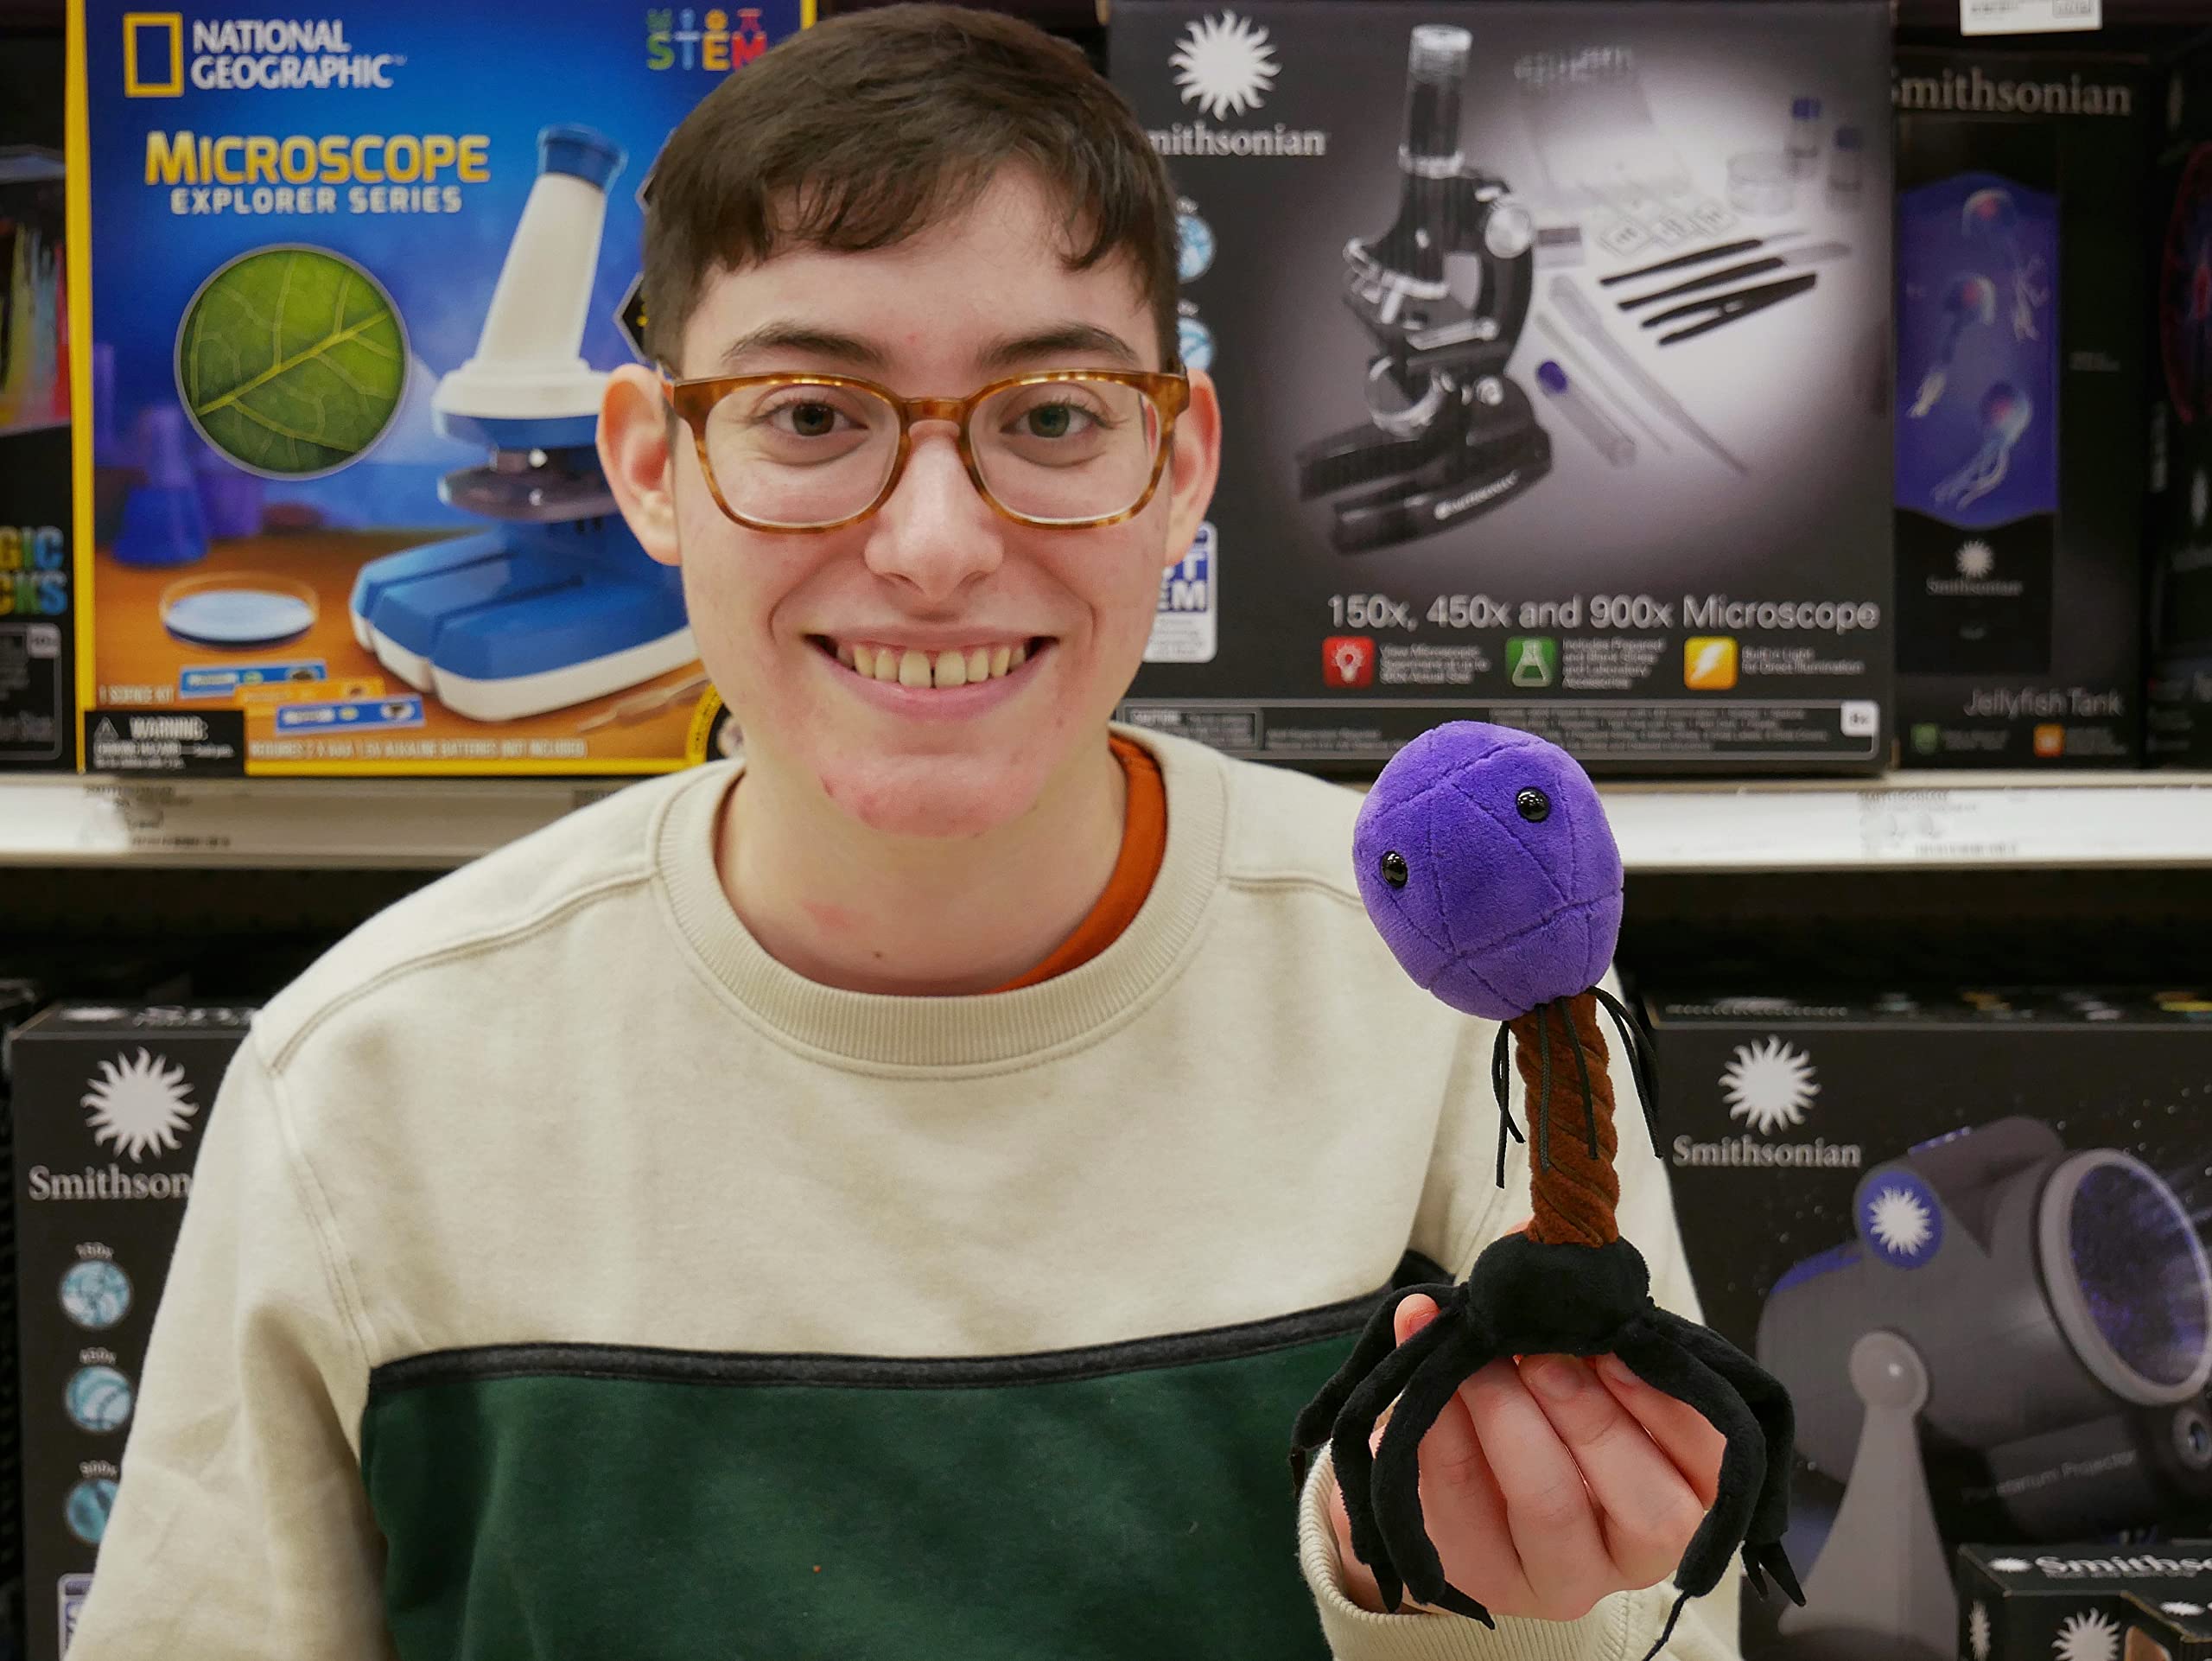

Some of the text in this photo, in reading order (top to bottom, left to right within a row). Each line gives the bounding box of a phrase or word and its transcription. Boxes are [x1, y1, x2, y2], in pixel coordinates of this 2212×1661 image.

[192, 19, 351, 54] NATIONAL
[646, 31, 766, 70] STEM
[1891, 67, 2131, 116] mithsonian
[171, 186, 463, 214] EXPLORER SERIES
[1328, 594, 1881, 635] 150x, 450x and 900x Microscope
[1963, 687, 2067, 722] Jellyfish
[2068, 687, 2126, 717] Tank
[1673, 1134, 1861, 1167] Smithsonian
[29, 1163, 194, 1200] Smithson
